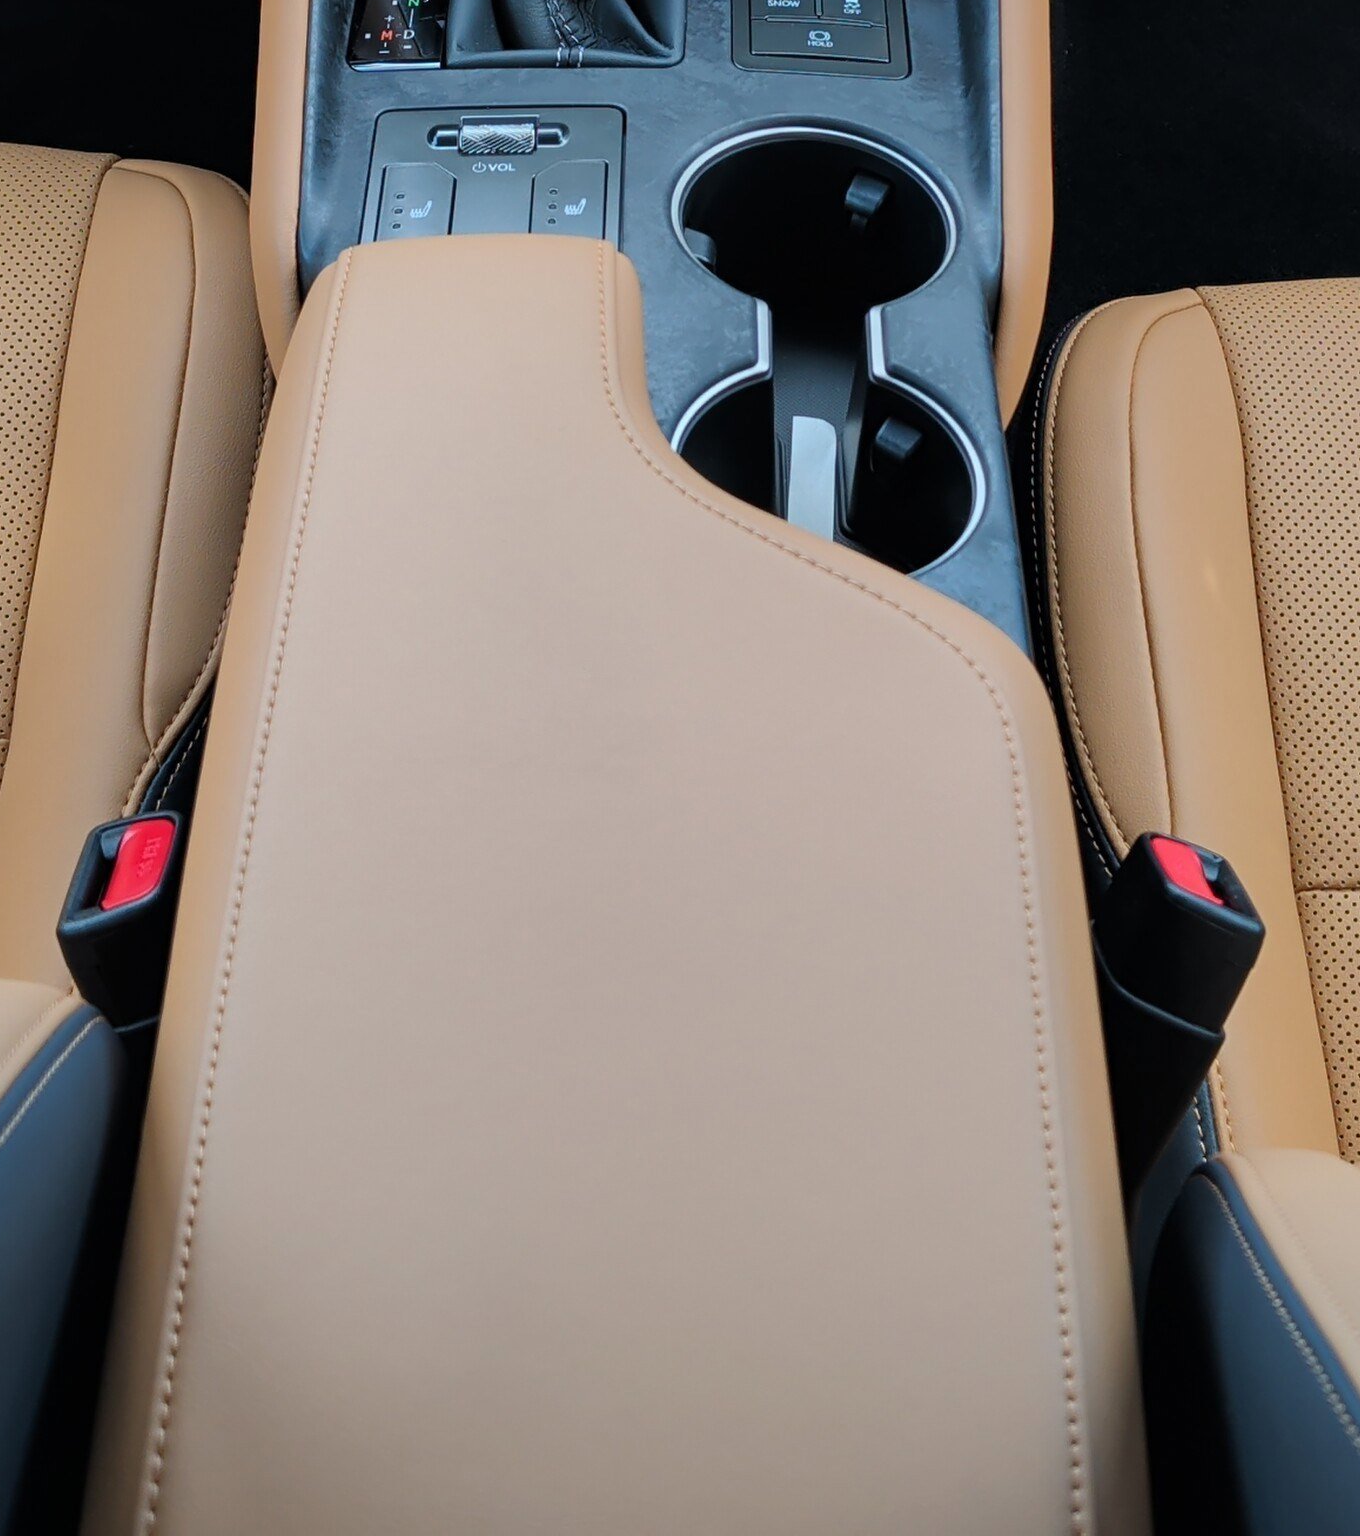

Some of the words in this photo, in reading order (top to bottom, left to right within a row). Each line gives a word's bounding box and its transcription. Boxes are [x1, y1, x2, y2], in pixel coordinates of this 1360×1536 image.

[767, 0, 801, 8] SNOW
[380, 29, 393, 41] M
[403, 29, 415, 40] D
[807, 40, 834, 48] HOLD
[488, 163, 516, 172] VOL
